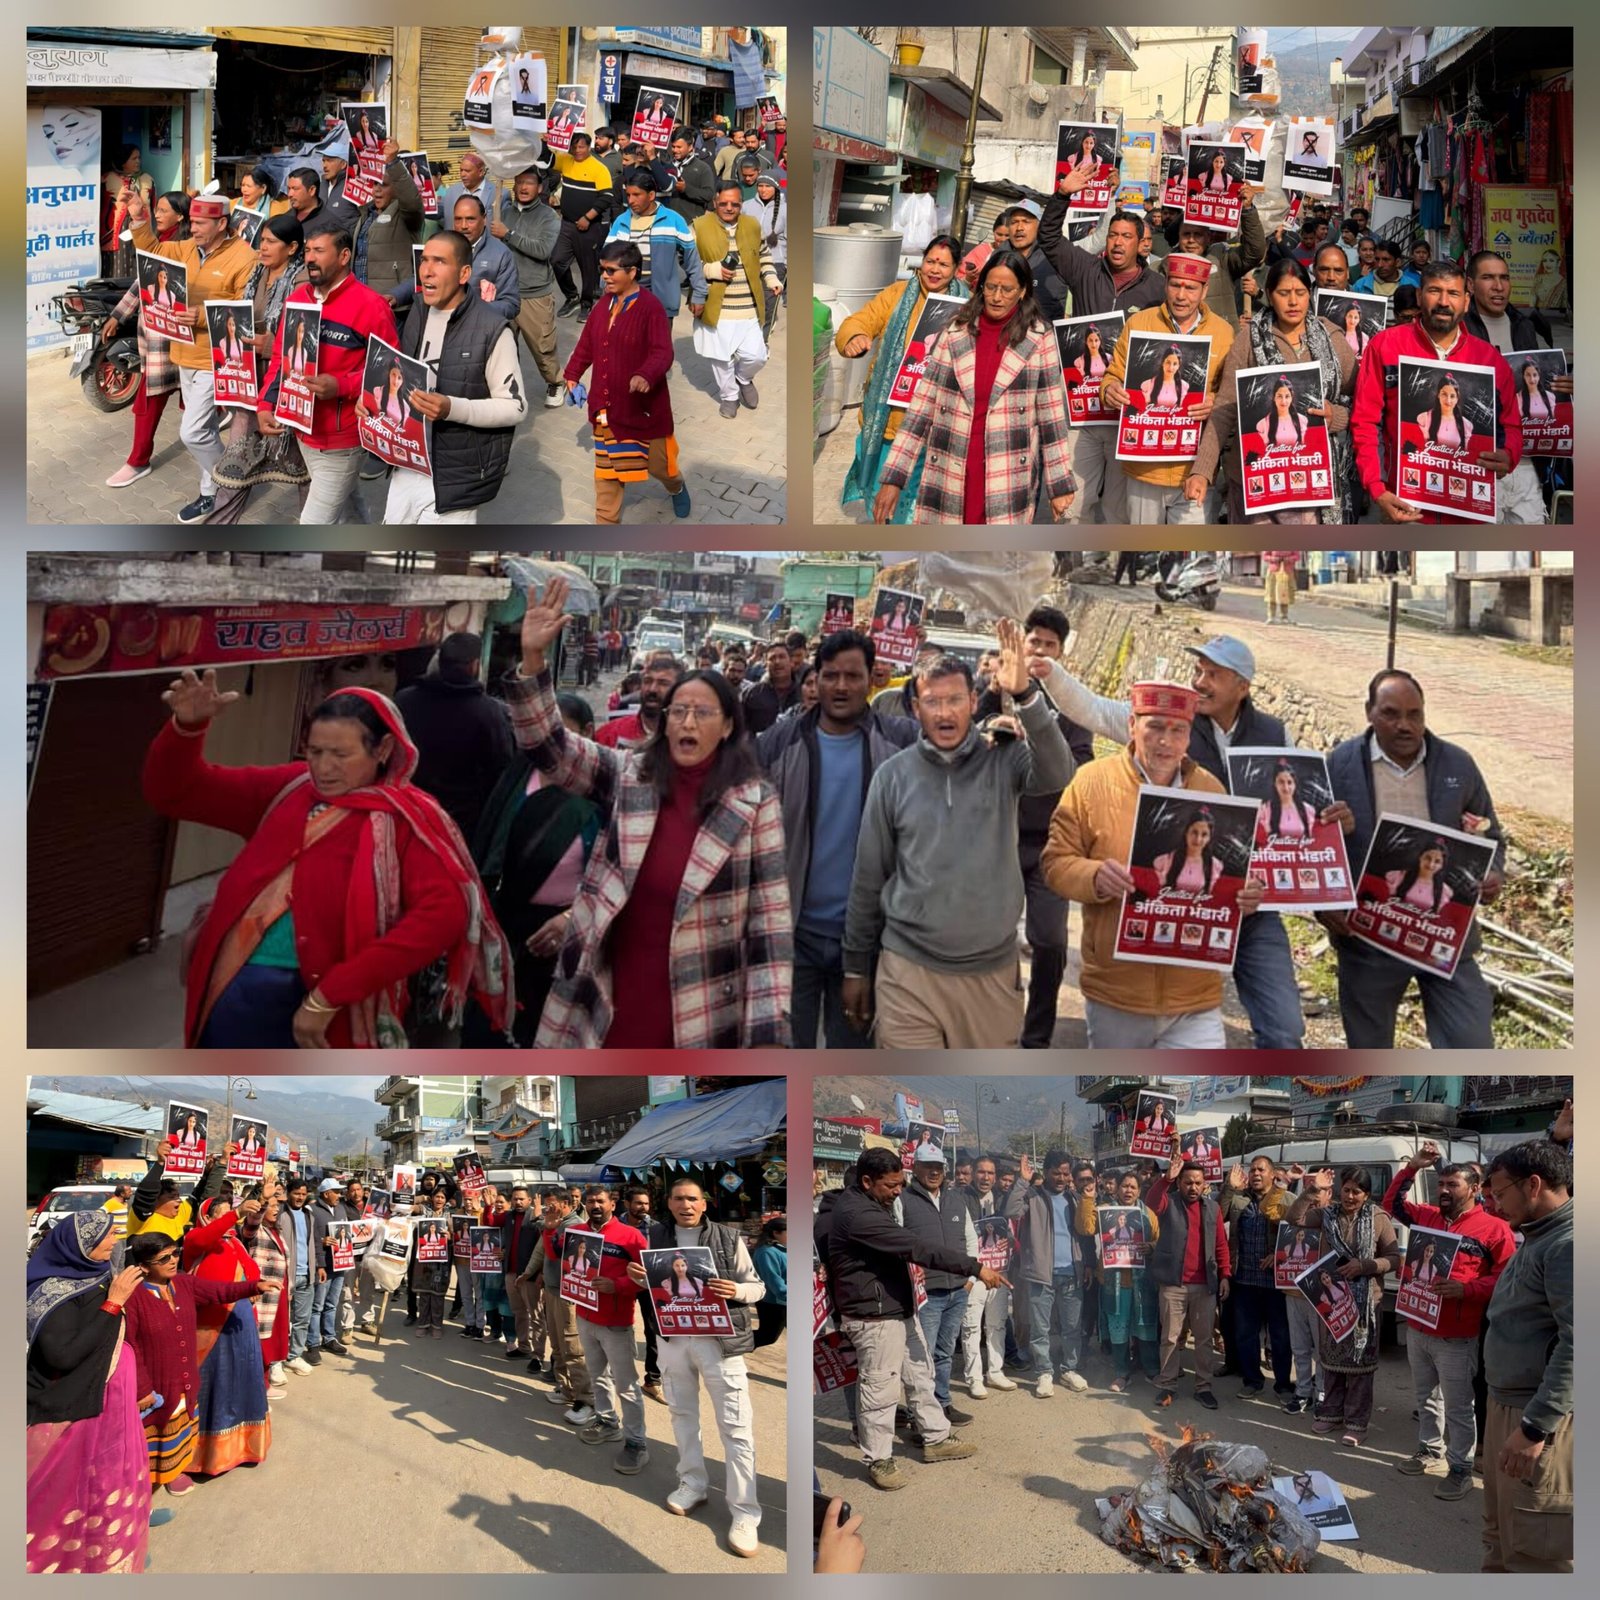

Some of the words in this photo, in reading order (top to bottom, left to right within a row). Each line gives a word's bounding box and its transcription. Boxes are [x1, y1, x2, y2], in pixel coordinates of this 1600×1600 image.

[27, 50, 109, 70] नुराग
[1489, 207, 1513, 223] जय
[26, 234, 51, 257] यूटी
[55, 229, 96, 248] पार्लर
[1071, 384, 1100, 396] अंकित
[1128, 413, 1166, 426] अंकिता
[1542, 424, 1570, 436] भंडारी
[1264, 443, 1292, 456] Justice
[1291, 440, 1307, 454] for
[1423, 440, 1454, 454] Justice
[1453, 446, 1469, 458] for
[1250, 454, 1290, 471] अंकिता
[1290, 451, 1323, 466] भंडारी
[1407, 450, 1451, 470] अंकिता
[1296, 846, 1337, 863] भंडारी
[1133, 898, 1187, 917] अंकिता
[1189, 903, 1232, 922] भंडारी
